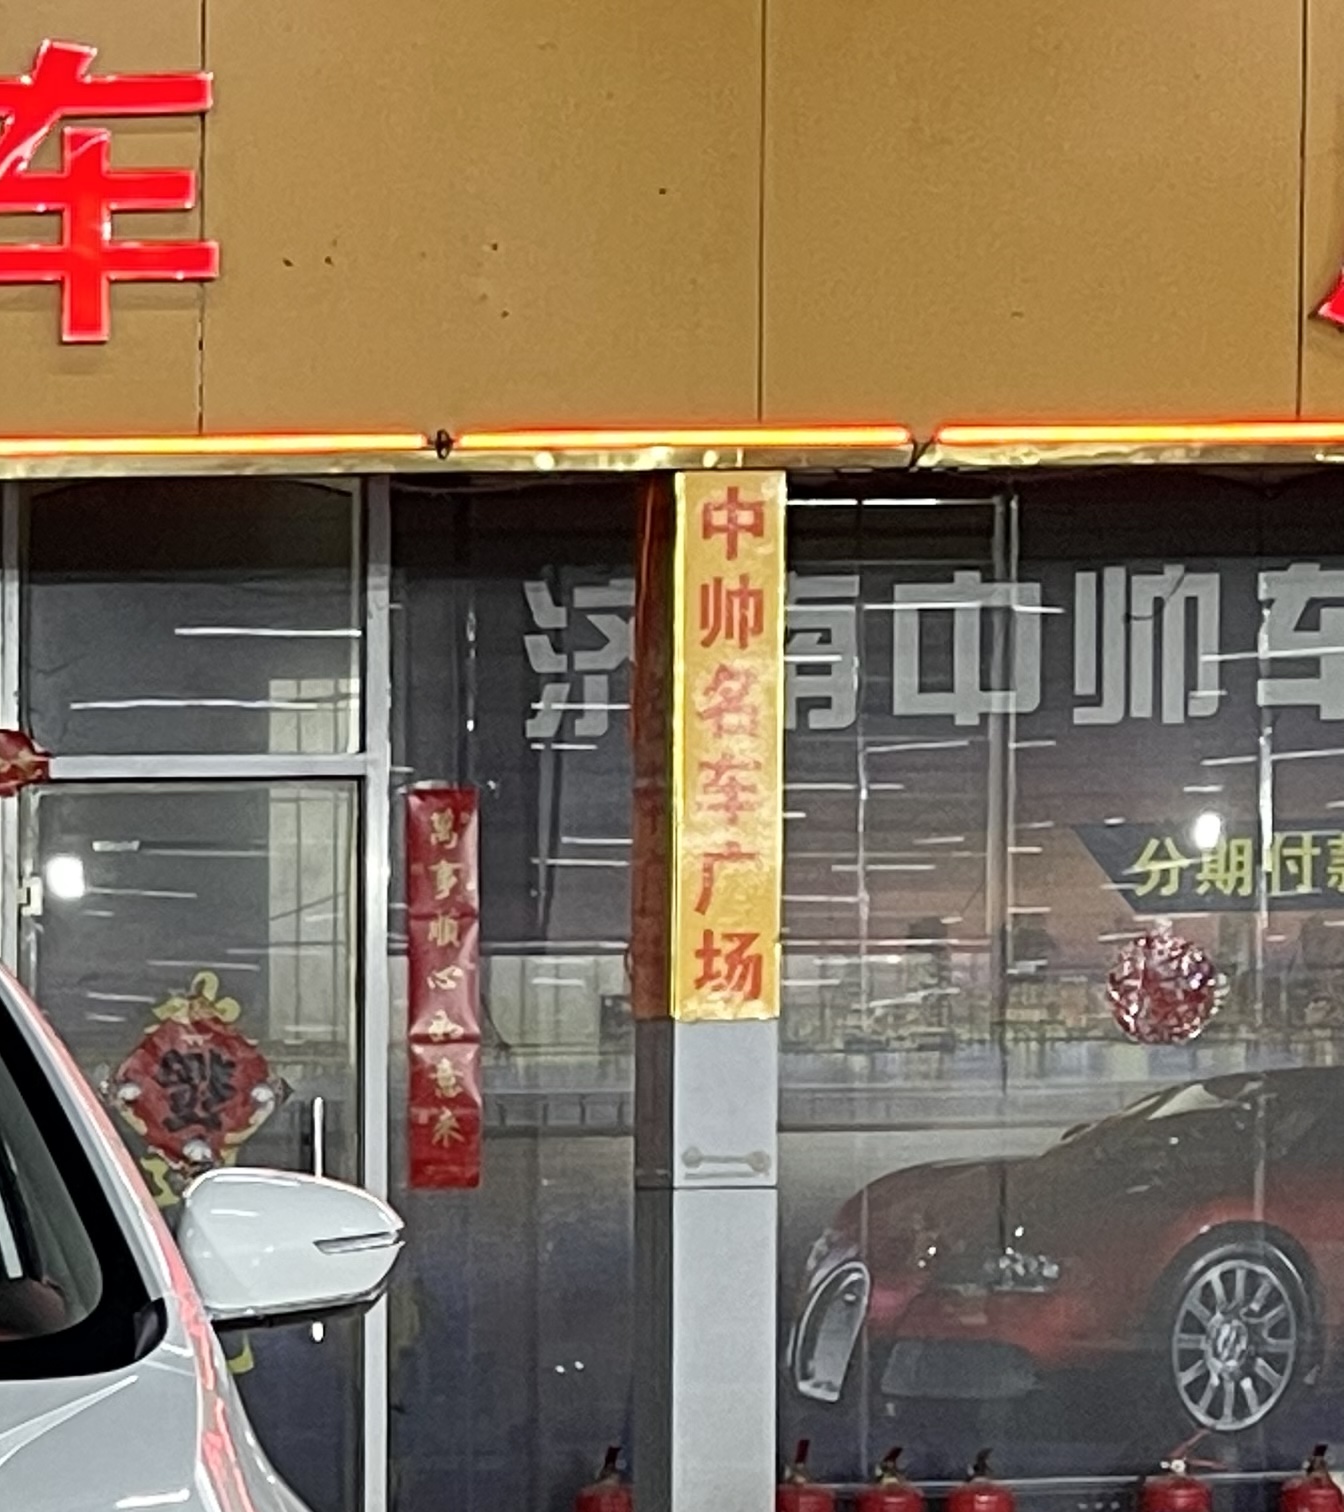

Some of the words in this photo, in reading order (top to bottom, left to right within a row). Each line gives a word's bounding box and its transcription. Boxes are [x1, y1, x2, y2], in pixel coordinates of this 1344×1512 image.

[692, 485, 766, 1003] 中帅名车广场
